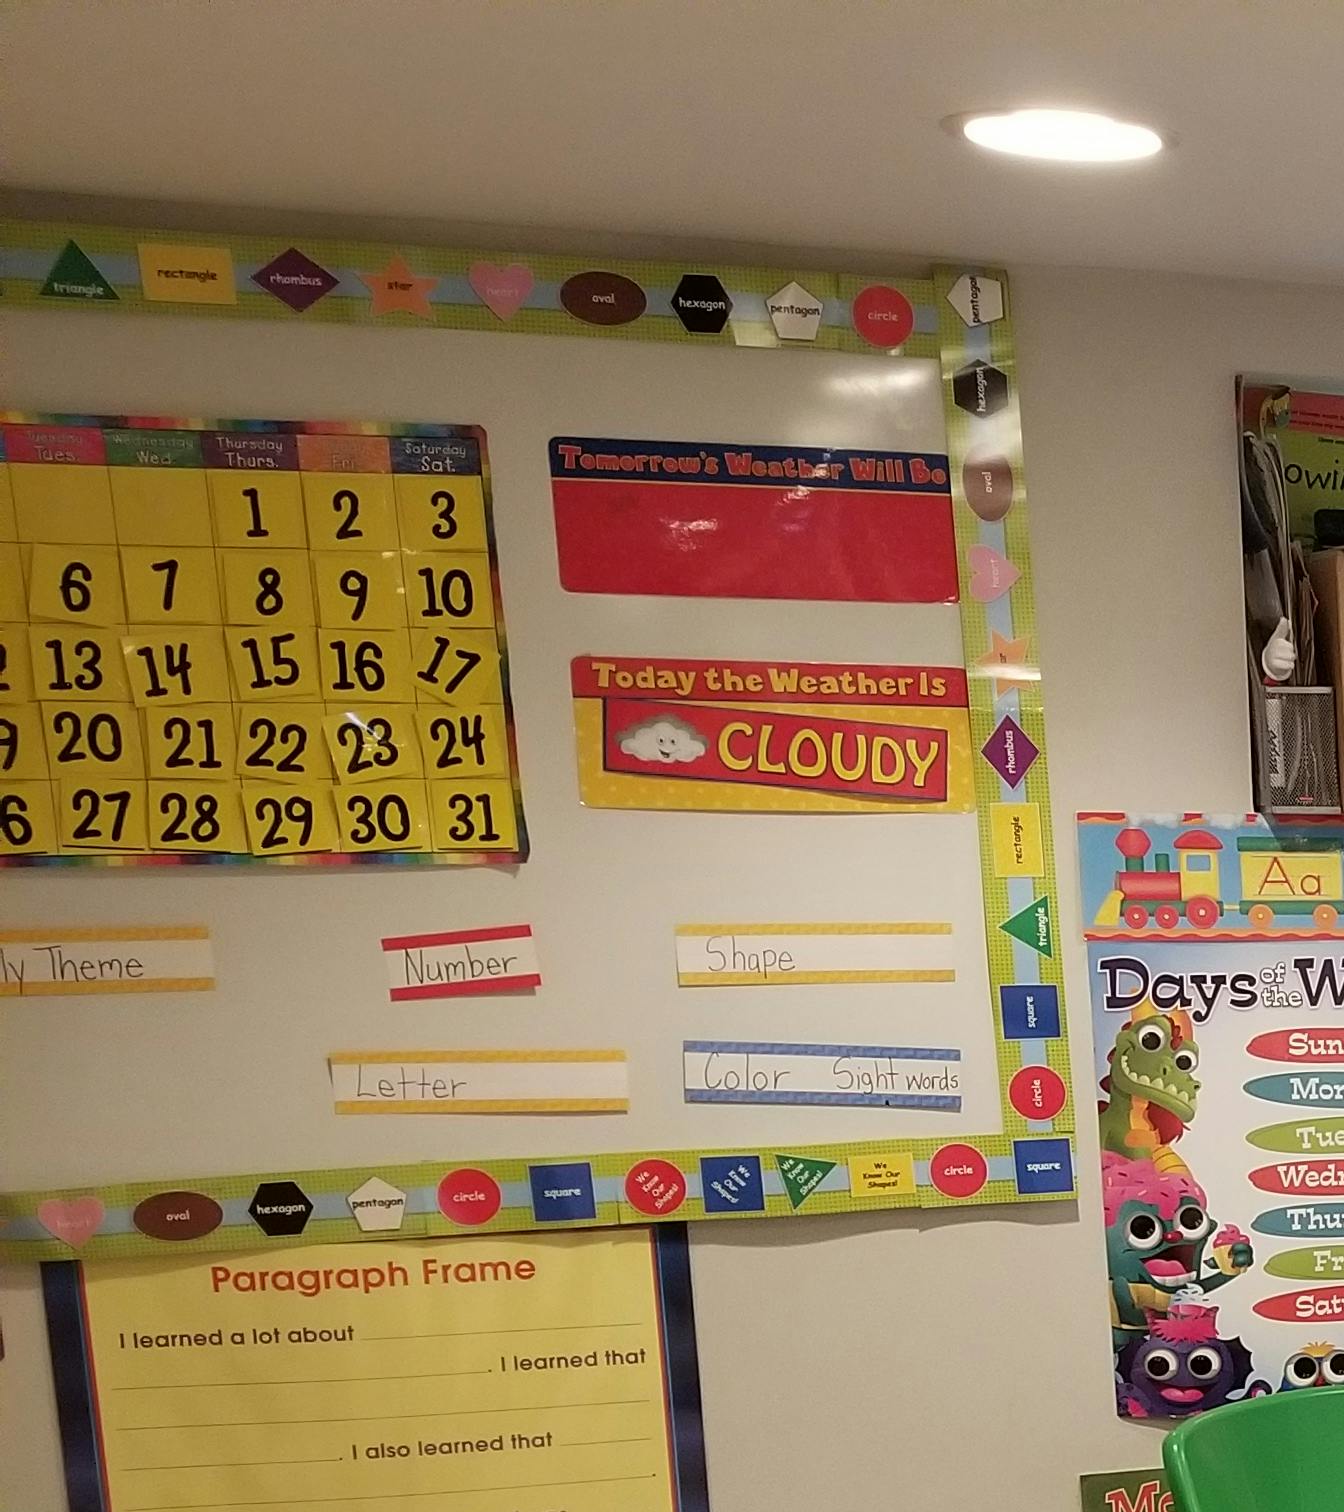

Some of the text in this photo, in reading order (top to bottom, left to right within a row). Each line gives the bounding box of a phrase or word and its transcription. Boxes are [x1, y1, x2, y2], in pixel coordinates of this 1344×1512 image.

[52, 280, 105, 297] triangle
[156, 267, 218, 284] rectangle
[268, 270, 323, 288] rhombus
[677, 296, 727, 313] hexagon
[769, 301, 822, 319] pentagon
[866, 308, 899, 322] circle
[215, 435, 284, 455] Thursday
[404, 440, 467, 460] Saturday
[557, 443, 720, 477] Tomorrow's
[725, 450, 845, 483] Weather
[849, 456, 906, 486] Will
[243, 488, 458, 540] 1 2 3
[152, 559, 475, 617] 7 8 10
[46, 639, 103, 691] 13
[590, 661, 697, 697] Today
[703, 664, 764, 694] the
[767, 668, 915, 698] Weather
[52, 711, 486, 769] 20 24
[716, 720, 939, 789] CLOUDY
[1003, 728, 1017, 776] rhombus
[72, 788, 500, 842] 27 31
[1012, 814, 1024, 866] rectangle
[32, 944, 146, 982] Theme
[403, 944, 519, 986] Number
[705, 935, 797, 980] Shape
[1259, 962, 1287, 984] of
[1099, 956, 1260, 1024] Days
[1261, 986, 1304, 1010] the
[356, 1064, 468, 1099] Letter
[703, 1051, 961, 1095] Color Sight words
[943, 1163, 975, 1177] circle
[1026, 1159, 1062, 1175] square
[255, 1202, 307, 1218] hexagon
[210, 1257, 537, 1297] Paragraph Frame
[132, 1328, 224, 1349] learned
[230, 1331, 247, 1346] a
[251, 1327, 281, 1346] lot
[286, 1324, 355, 1344] about
